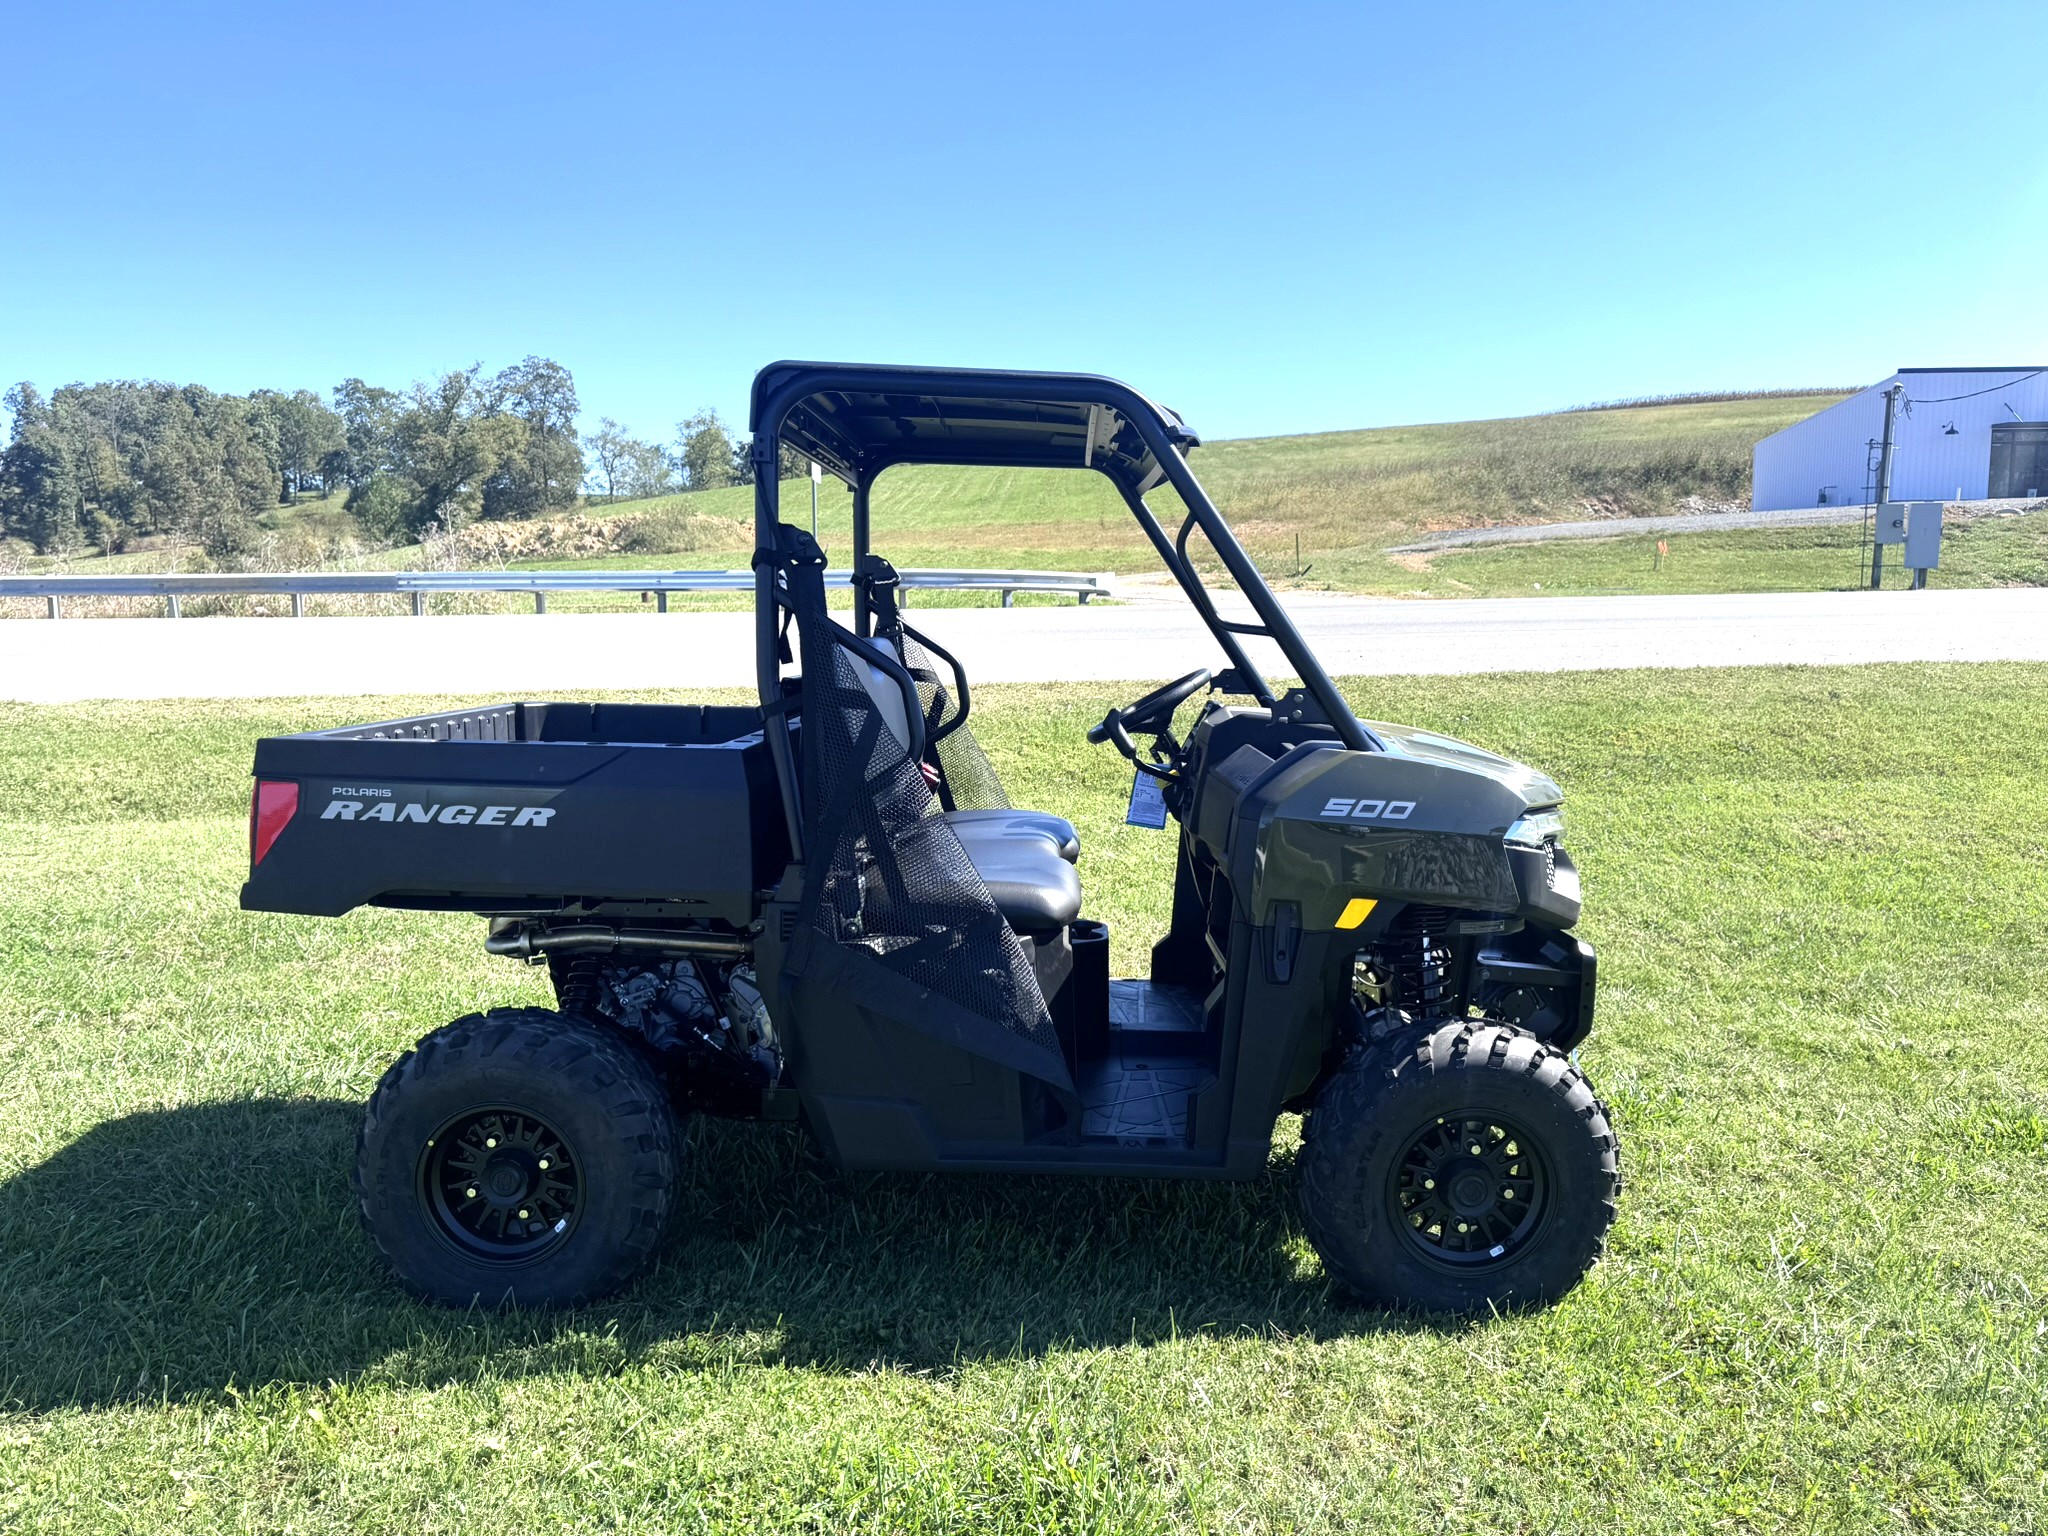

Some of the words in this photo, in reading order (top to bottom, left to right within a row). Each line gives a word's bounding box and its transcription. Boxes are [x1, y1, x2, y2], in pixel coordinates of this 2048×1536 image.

[332, 786, 392, 797] POLARIS
[320, 800, 557, 827] RANGER
[1319, 798, 1417, 820] 500
